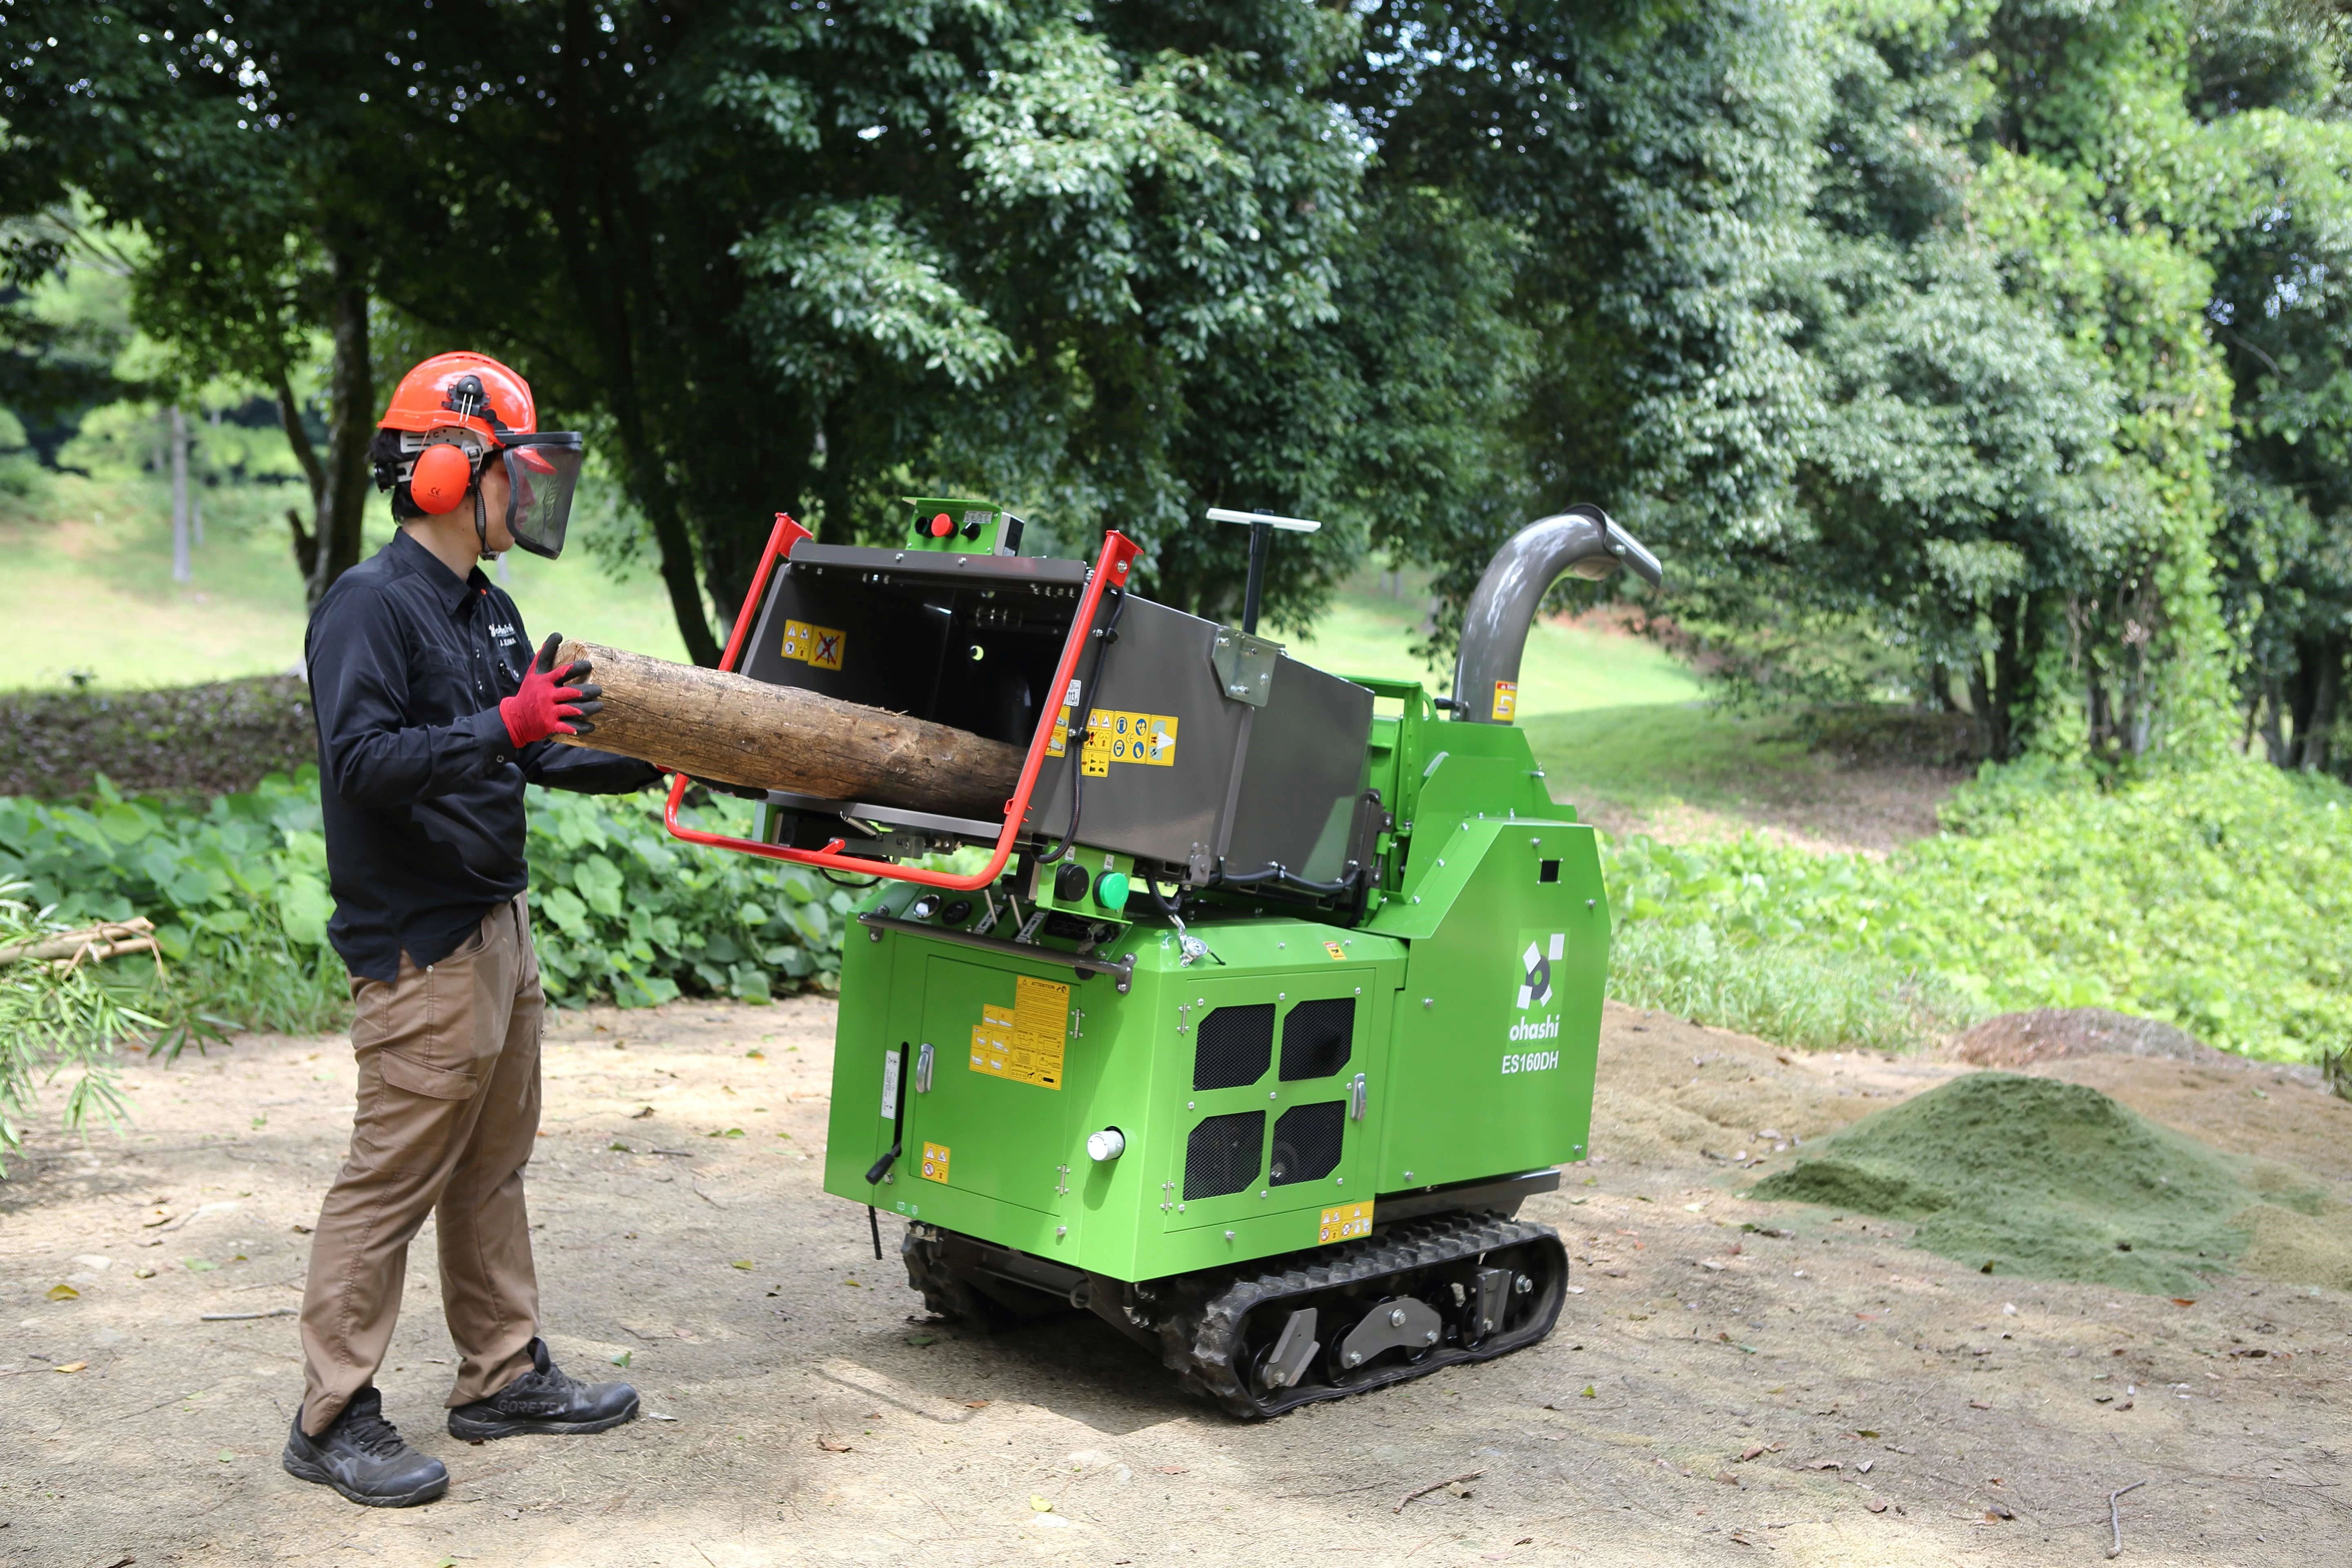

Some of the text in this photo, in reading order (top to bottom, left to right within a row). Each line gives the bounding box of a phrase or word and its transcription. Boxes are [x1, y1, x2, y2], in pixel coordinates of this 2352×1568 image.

[1031, 981, 1055, 990] ATTENTION
[1510, 1014, 1560, 1041] ohashi
[1501, 1050, 1559, 1074] ES160DH
[498, 1399, 568, 1413] GORE-TEX
